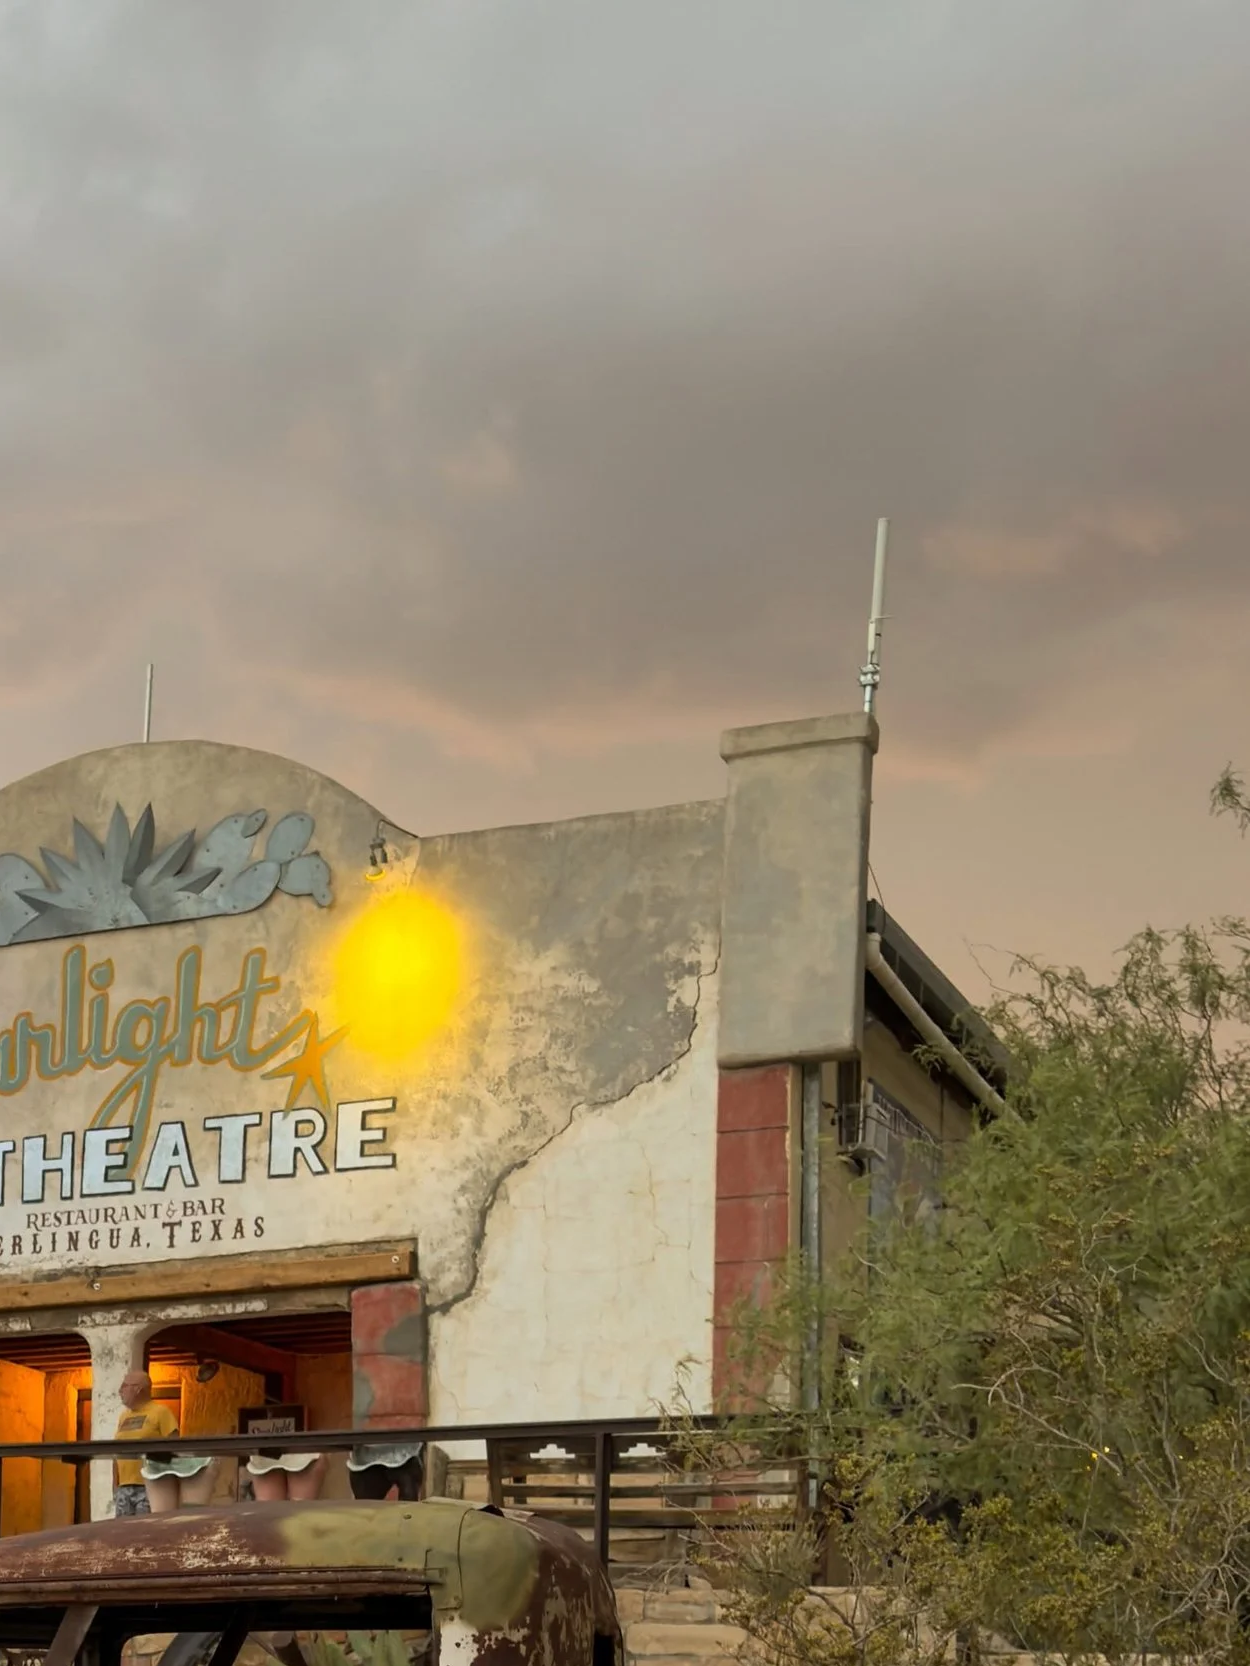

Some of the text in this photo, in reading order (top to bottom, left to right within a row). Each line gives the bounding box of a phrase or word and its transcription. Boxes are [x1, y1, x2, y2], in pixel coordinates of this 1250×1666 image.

[25, 1207, 163, 1232] RESTAURANT
[182, 1197, 226, 1217] BAR
[162, 1217, 266, 1248] TEXAS
